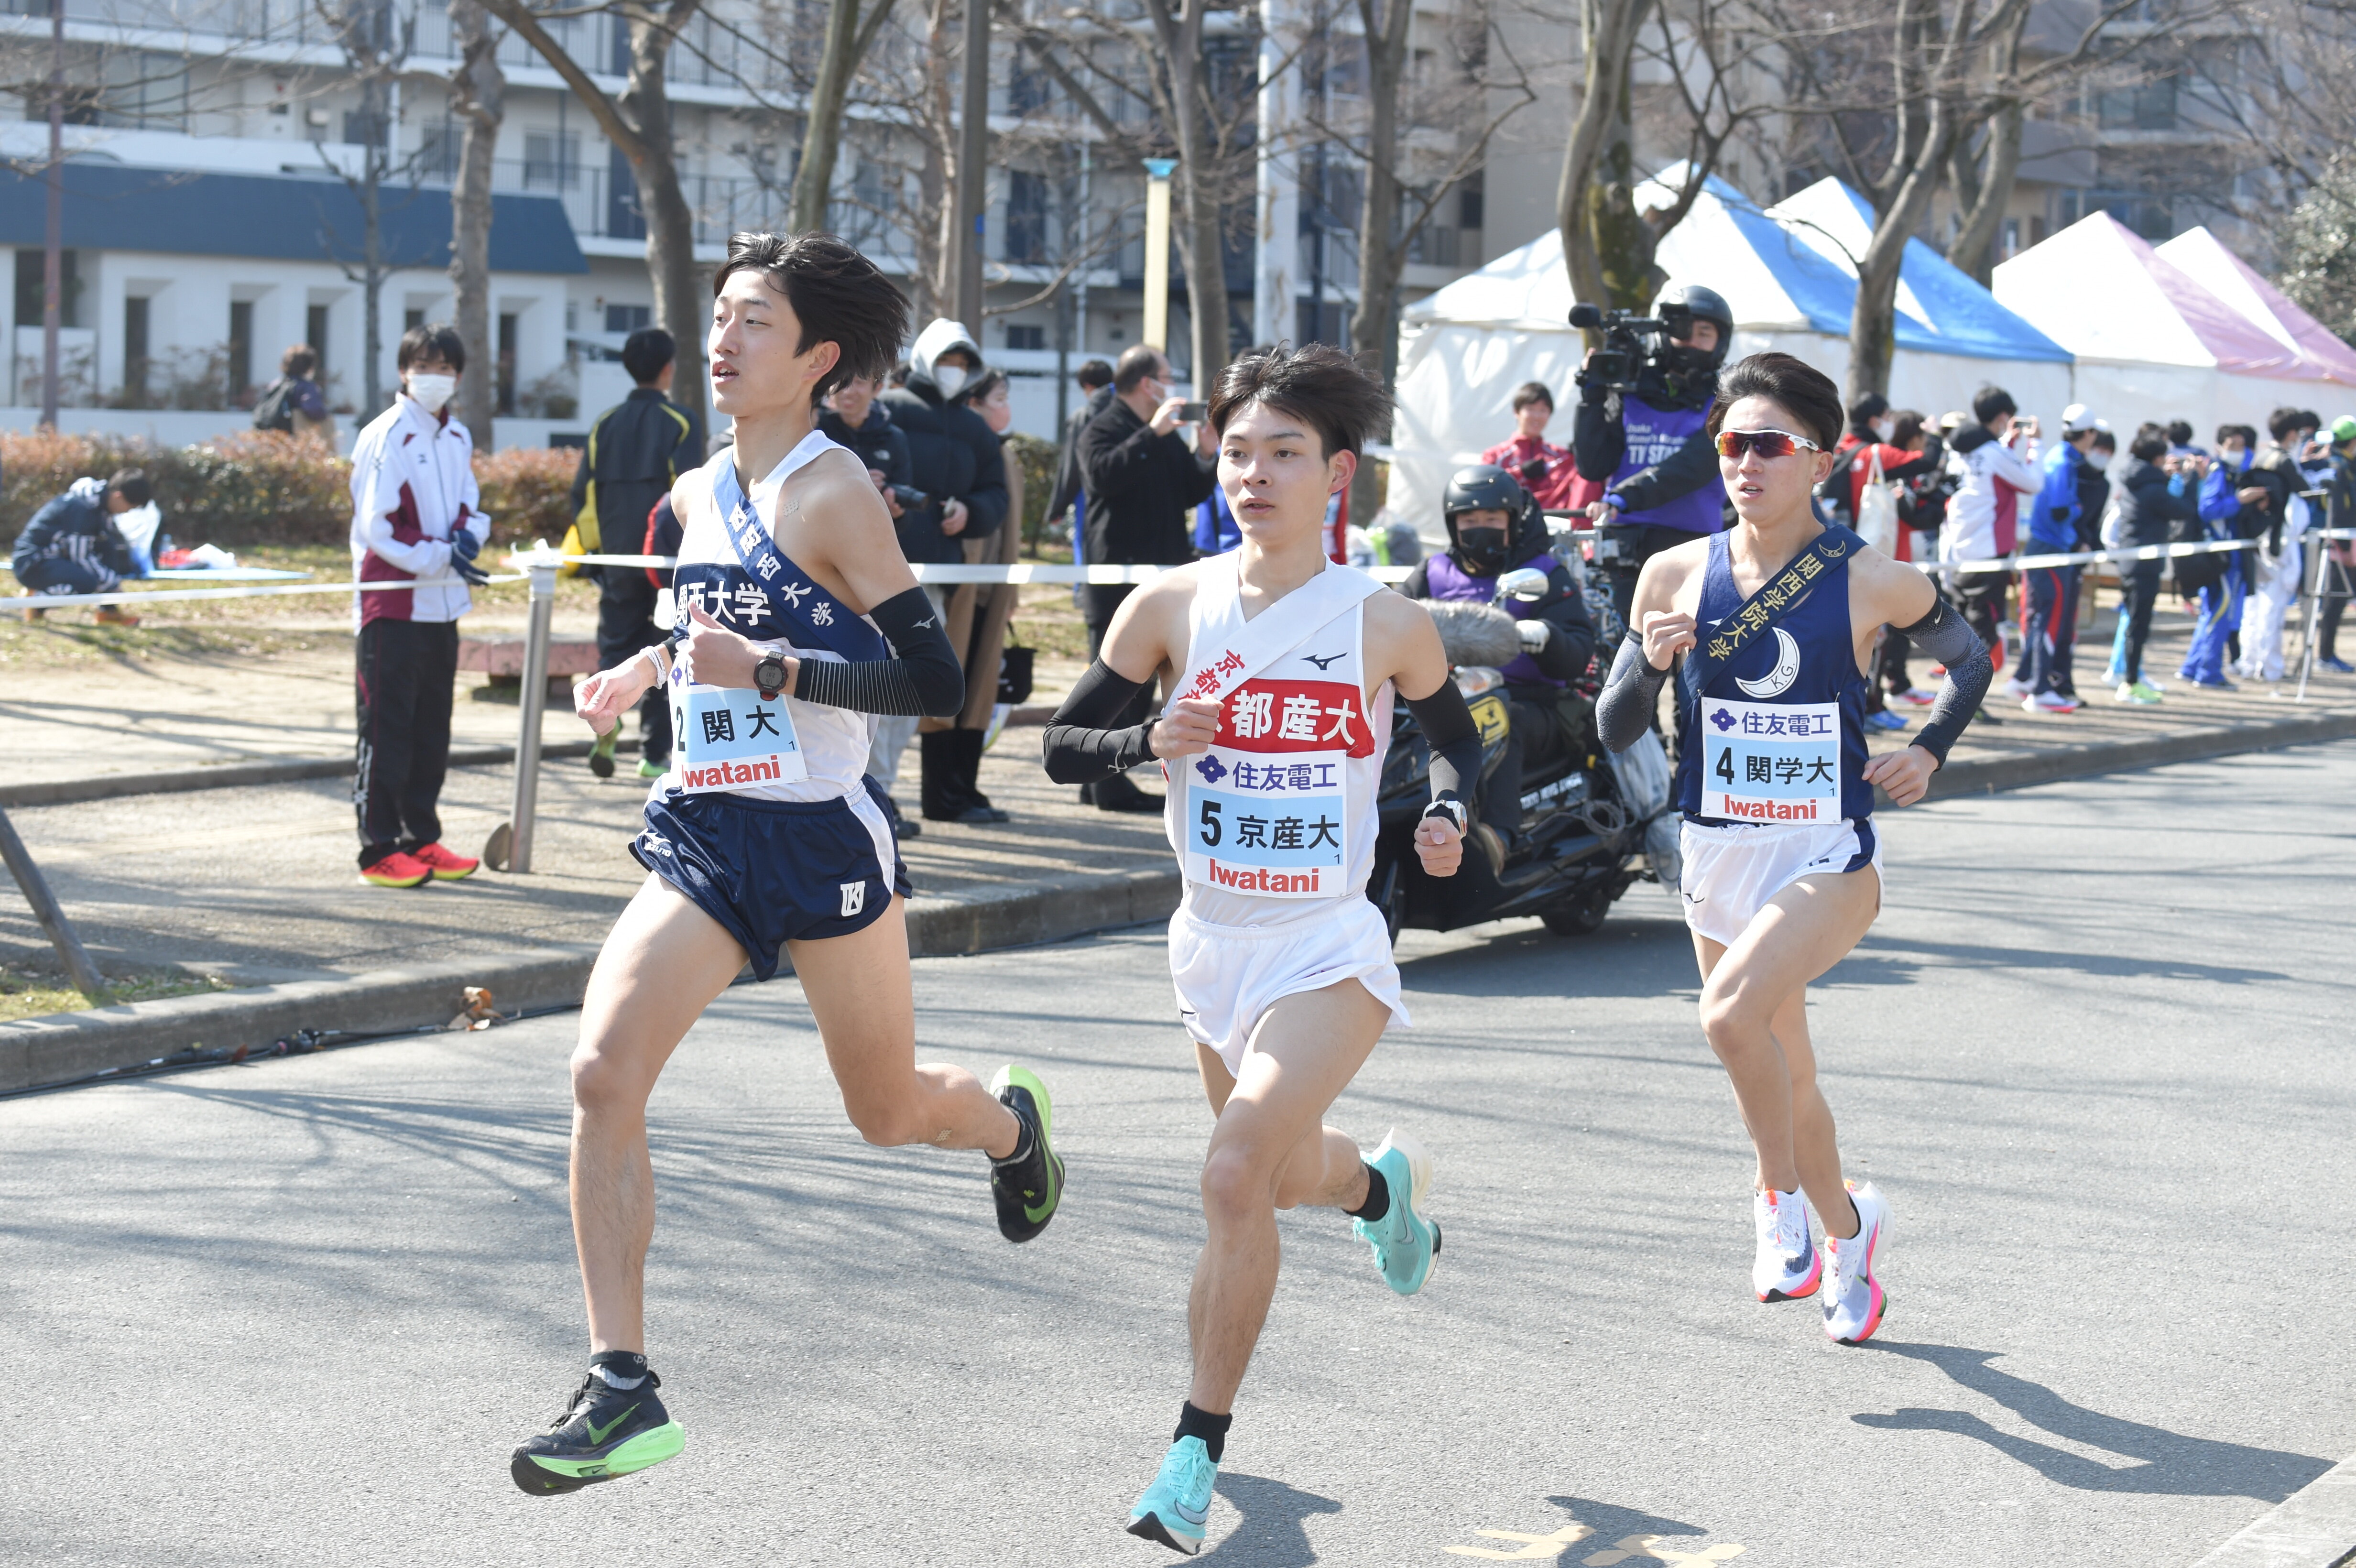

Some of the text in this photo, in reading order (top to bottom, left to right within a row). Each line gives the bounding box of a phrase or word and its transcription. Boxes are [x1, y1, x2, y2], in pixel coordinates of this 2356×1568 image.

[1628, 445, 1647, 465] TV
[1708, 553, 1824, 661] 関西学院大学
[1770, 663, 1795, 689] K.G.
[676, 706, 686, 751] 2
[1216, 689, 1357, 745] 都産大
[1742, 711, 1832, 736] 住友電工
[788, 740, 795, 750] 1
[1233, 761, 1337, 791] 住友電工
[1716, 747, 1834, 785] 4 関学大
[1829, 787, 1835, 796] 1
[1724, 794, 1817, 819] Iwatani
[1200, 800, 1340, 849] 5 京産大
[1333, 853, 1340, 864] 1
[1210, 858, 1319, 893] Iwatani
